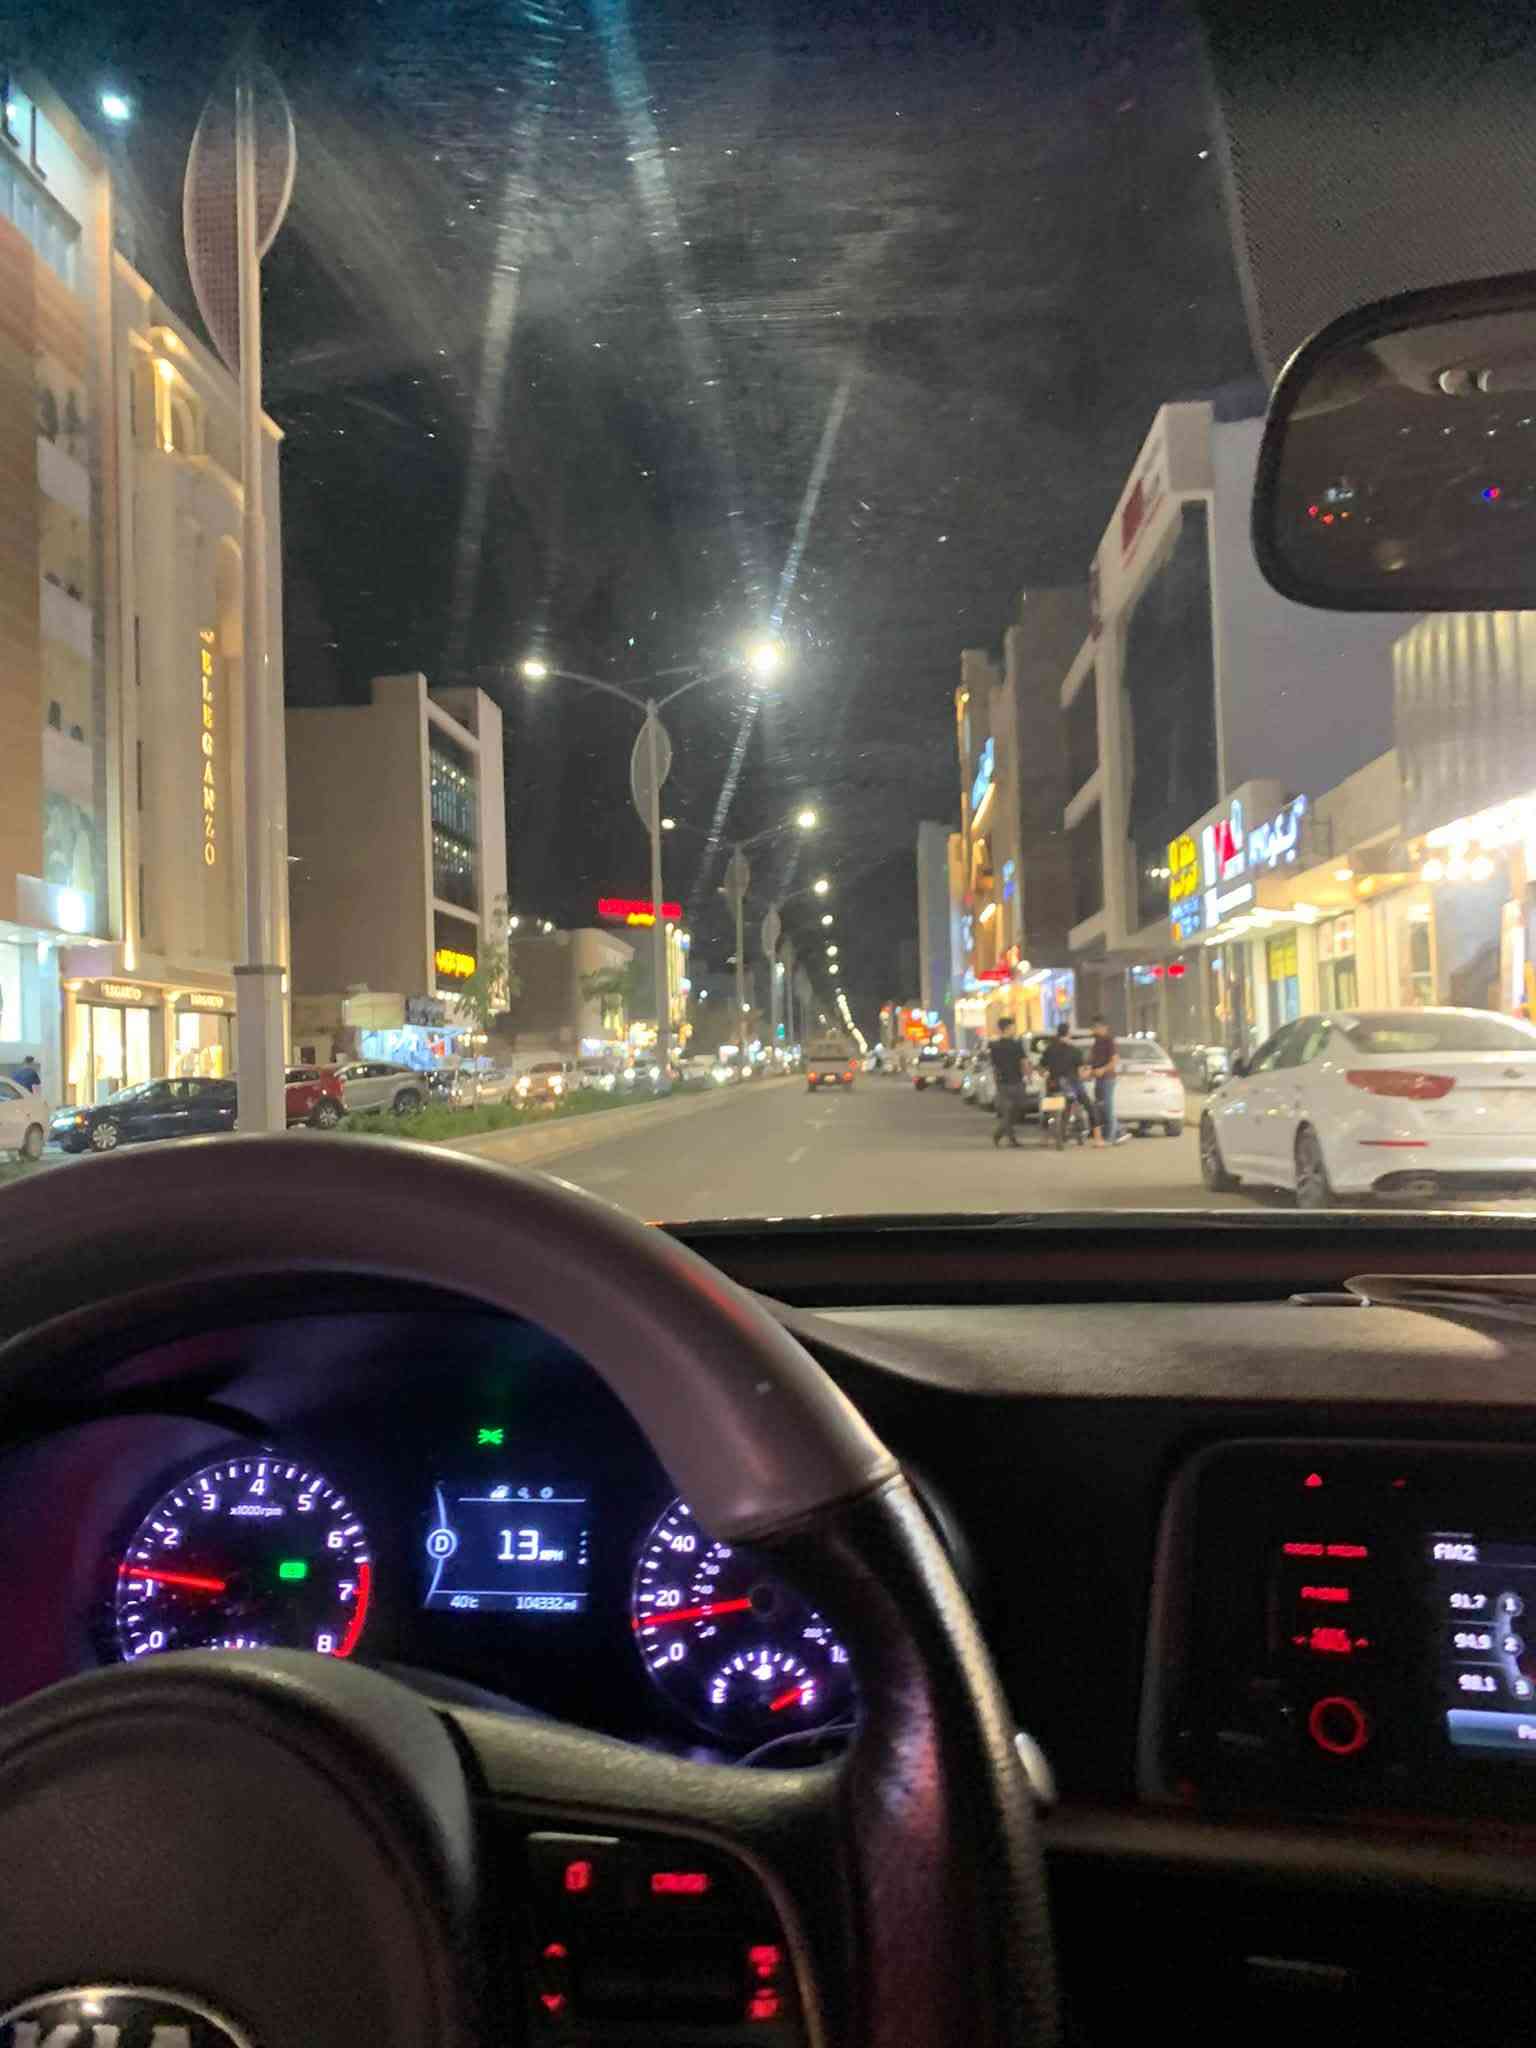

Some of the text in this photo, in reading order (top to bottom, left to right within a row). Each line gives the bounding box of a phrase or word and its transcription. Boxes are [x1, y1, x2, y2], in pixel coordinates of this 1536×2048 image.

[201, 648, 215, 865] ELEGANZO
[249, 1478, 266, 1496] 4
[201, 1494, 217, 1511] 3
[297, 1494, 313, 1512] 5
[162, 1527, 180, 1545] 2
[327, 1531, 344, 1549] 6
[434, 1535, 450, 1552] D
[497, 1529, 540, 1561] 13
[670, 1535, 696, 1552] 40
[144, 1579, 153, 1597] 1
[337, 1583, 354, 1601] 7
[655, 1589, 680, 1607] 20
[149, 1630, 163, 1649] 0
[317, 1634, 332, 1653] 8
[669, 1643, 684, 1661] 0
[711, 1688, 726, 1704] E
